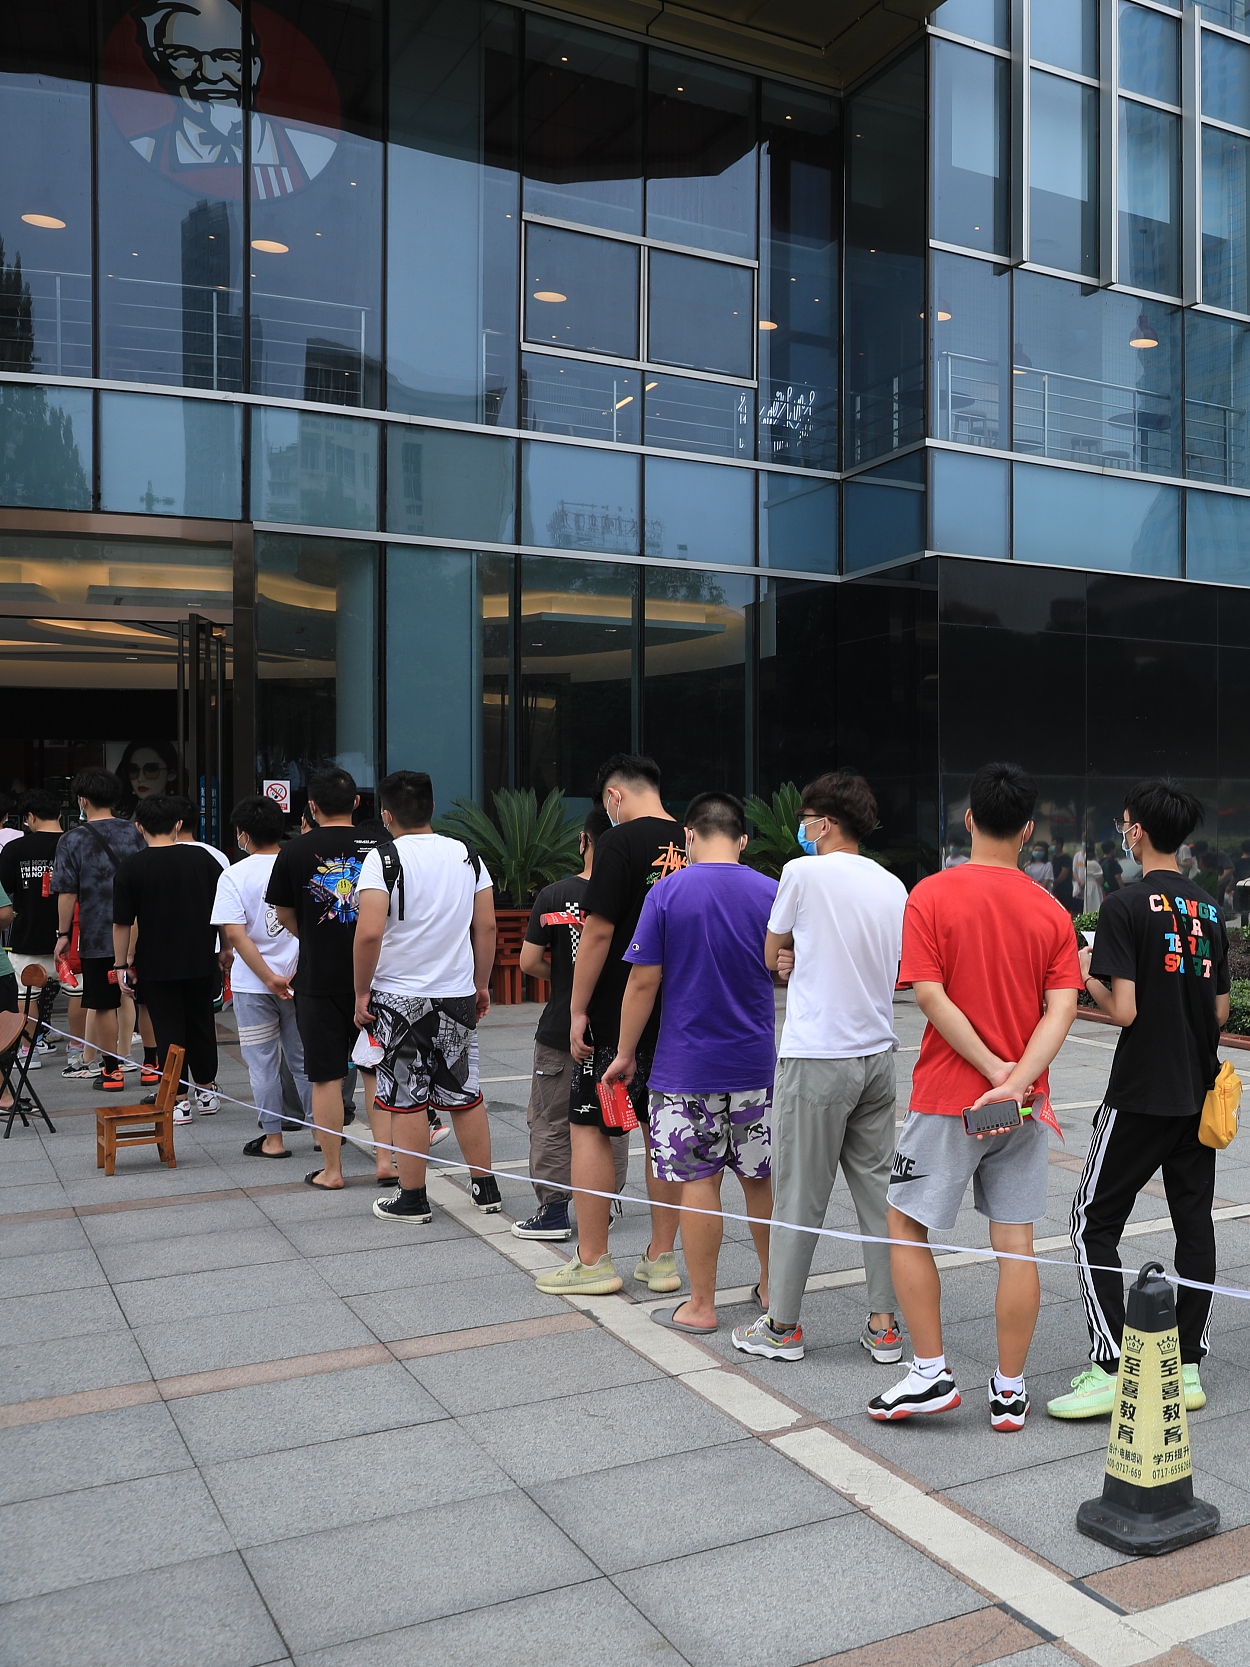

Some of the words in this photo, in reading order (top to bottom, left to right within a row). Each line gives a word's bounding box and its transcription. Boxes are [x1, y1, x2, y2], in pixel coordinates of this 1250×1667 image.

[1191, 918, 1203, 937] A
[1165, 953, 1212, 978] SRT
[1117, 1355, 1141, 1444] 至喜教育
[1160, 1356, 1182, 1446] 至喜教育
[1153, 1445, 1190, 1465] 学历提升
